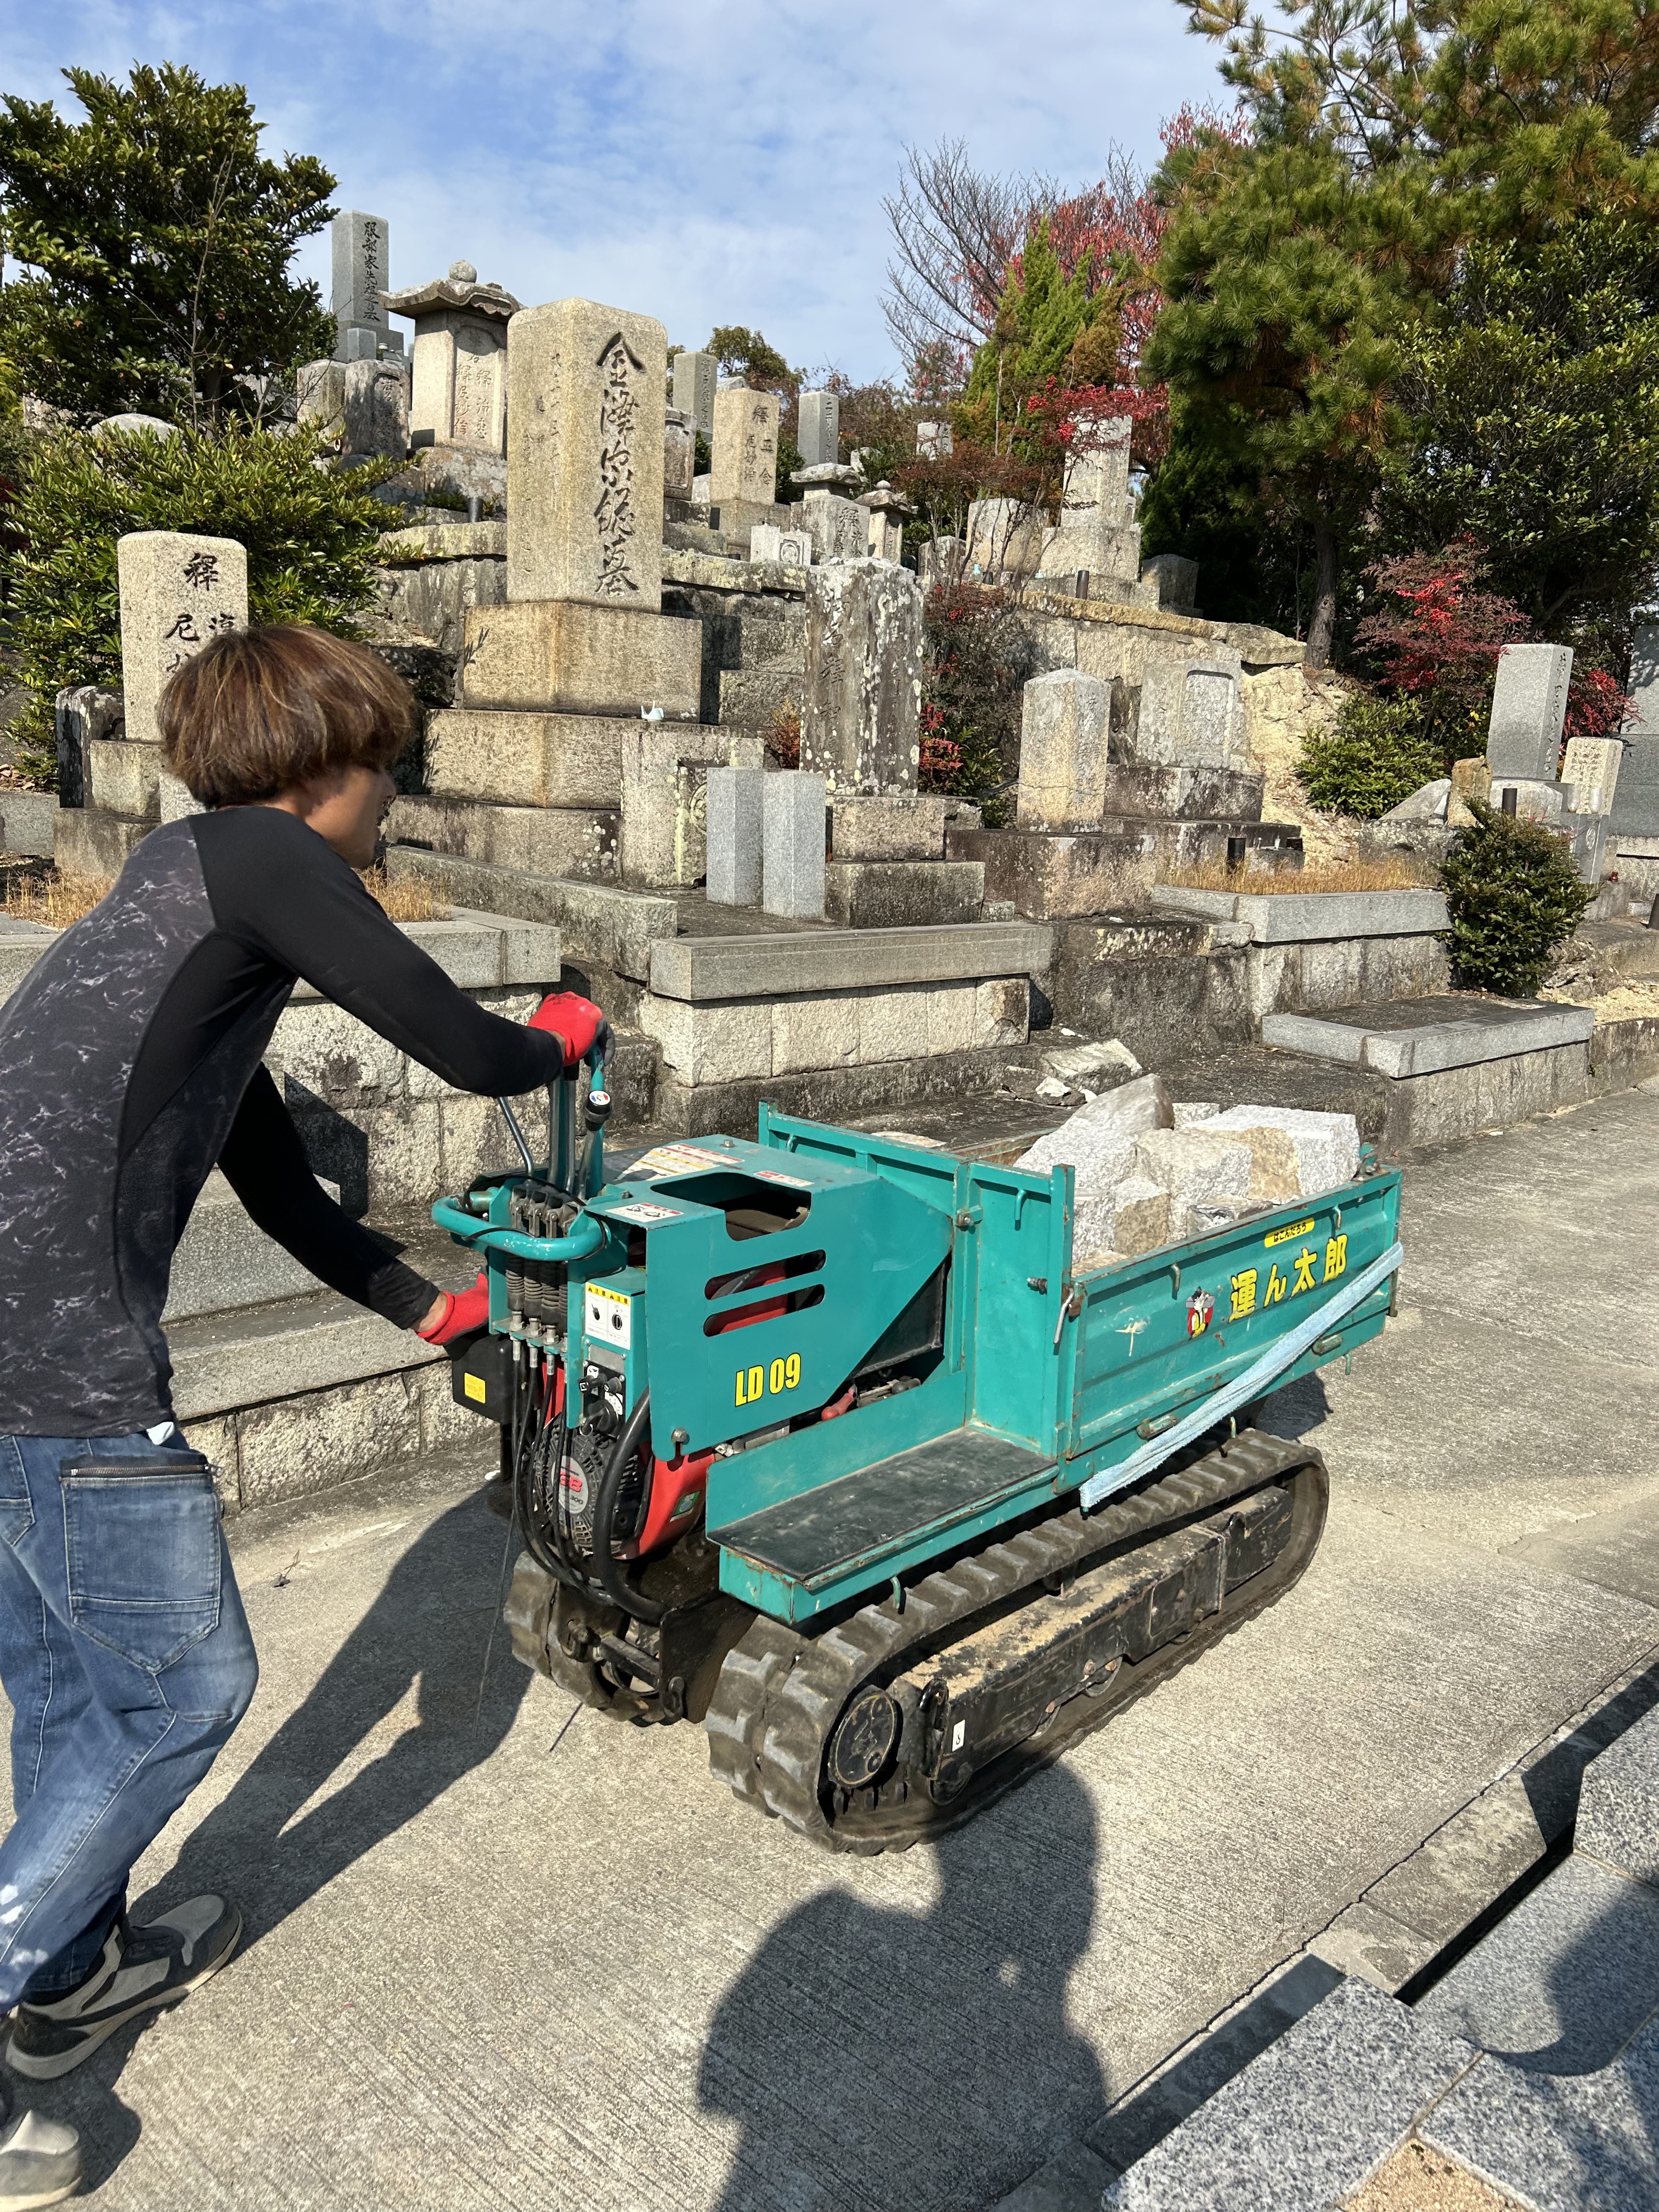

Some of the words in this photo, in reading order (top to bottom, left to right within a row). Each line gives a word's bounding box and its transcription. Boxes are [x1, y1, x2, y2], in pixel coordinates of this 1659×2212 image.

[362, 221, 380, 321] 服部家先祖之墓
[1228, 1233, 1348, 1324] 運ん太郎
[735, 1364, 764, 1407] LD
[769, 1352, 801, 1395] 09
